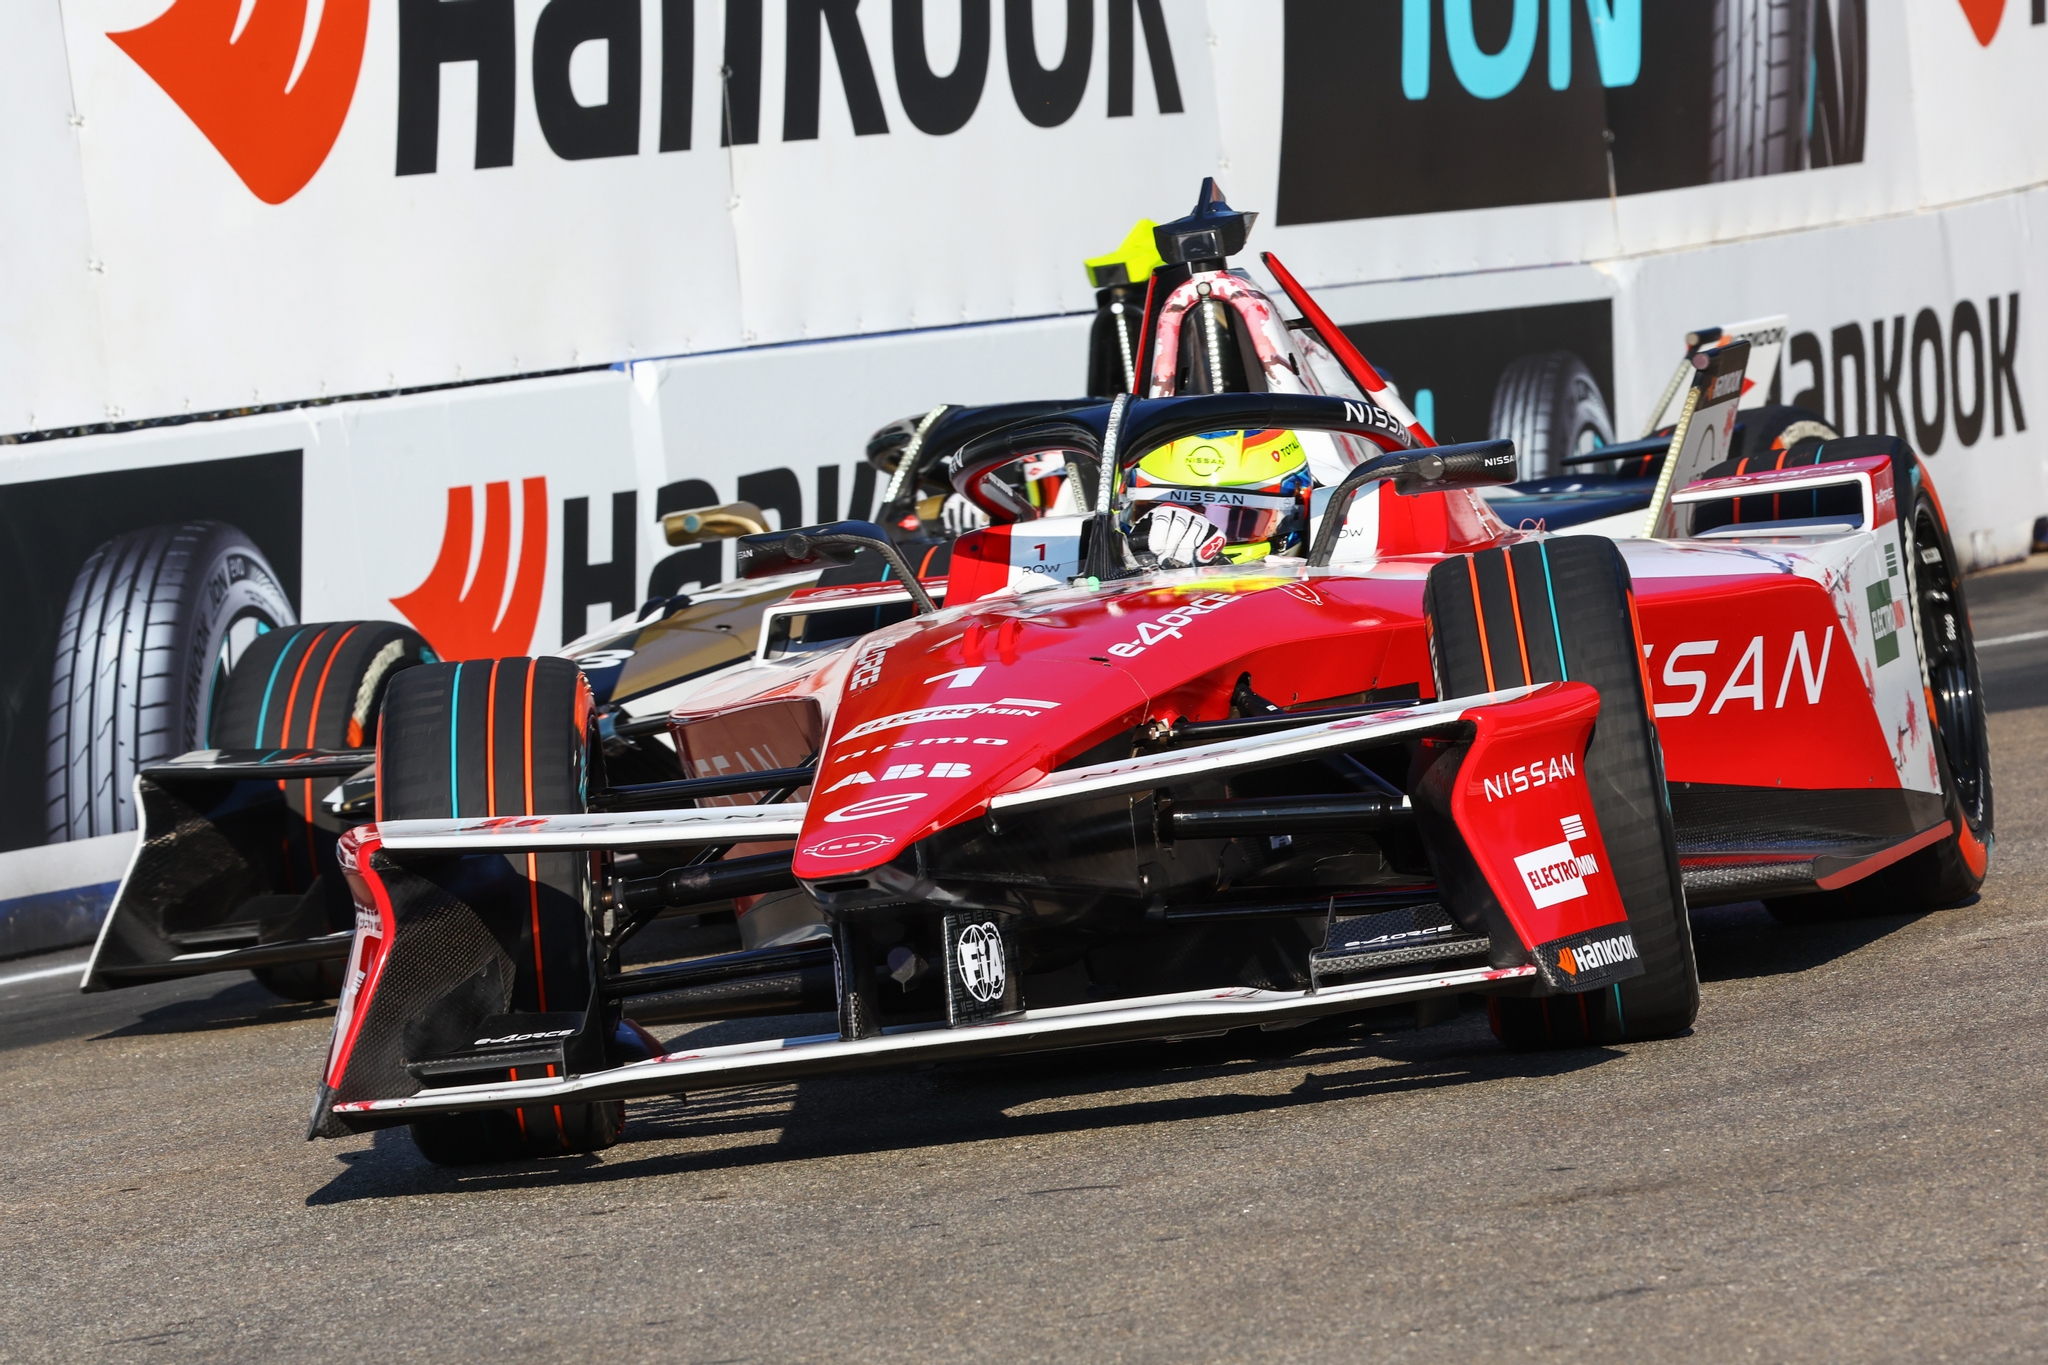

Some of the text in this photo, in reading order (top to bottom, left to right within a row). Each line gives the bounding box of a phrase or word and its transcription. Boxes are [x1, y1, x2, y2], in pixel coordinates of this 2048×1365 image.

[1766, 291, 2027, 456] anKOOK
[1484, 454, 1516, 467] NISSA
[1170, 490, 1244, 505] NISSAN
[1034, 543, 1046, 561] 1
[1022, 563, 1061, 577] ROW
[923, 666, 987, 689] 1
[834, 737, 1009, 763] nismo
[821, 762, 973, 795] ABB
[1484, 753, 1576, 802] NISSAN
[802, 837, 896, 854] NISSAN
[1527, 853, 1600, 891] ELECTROMIN
